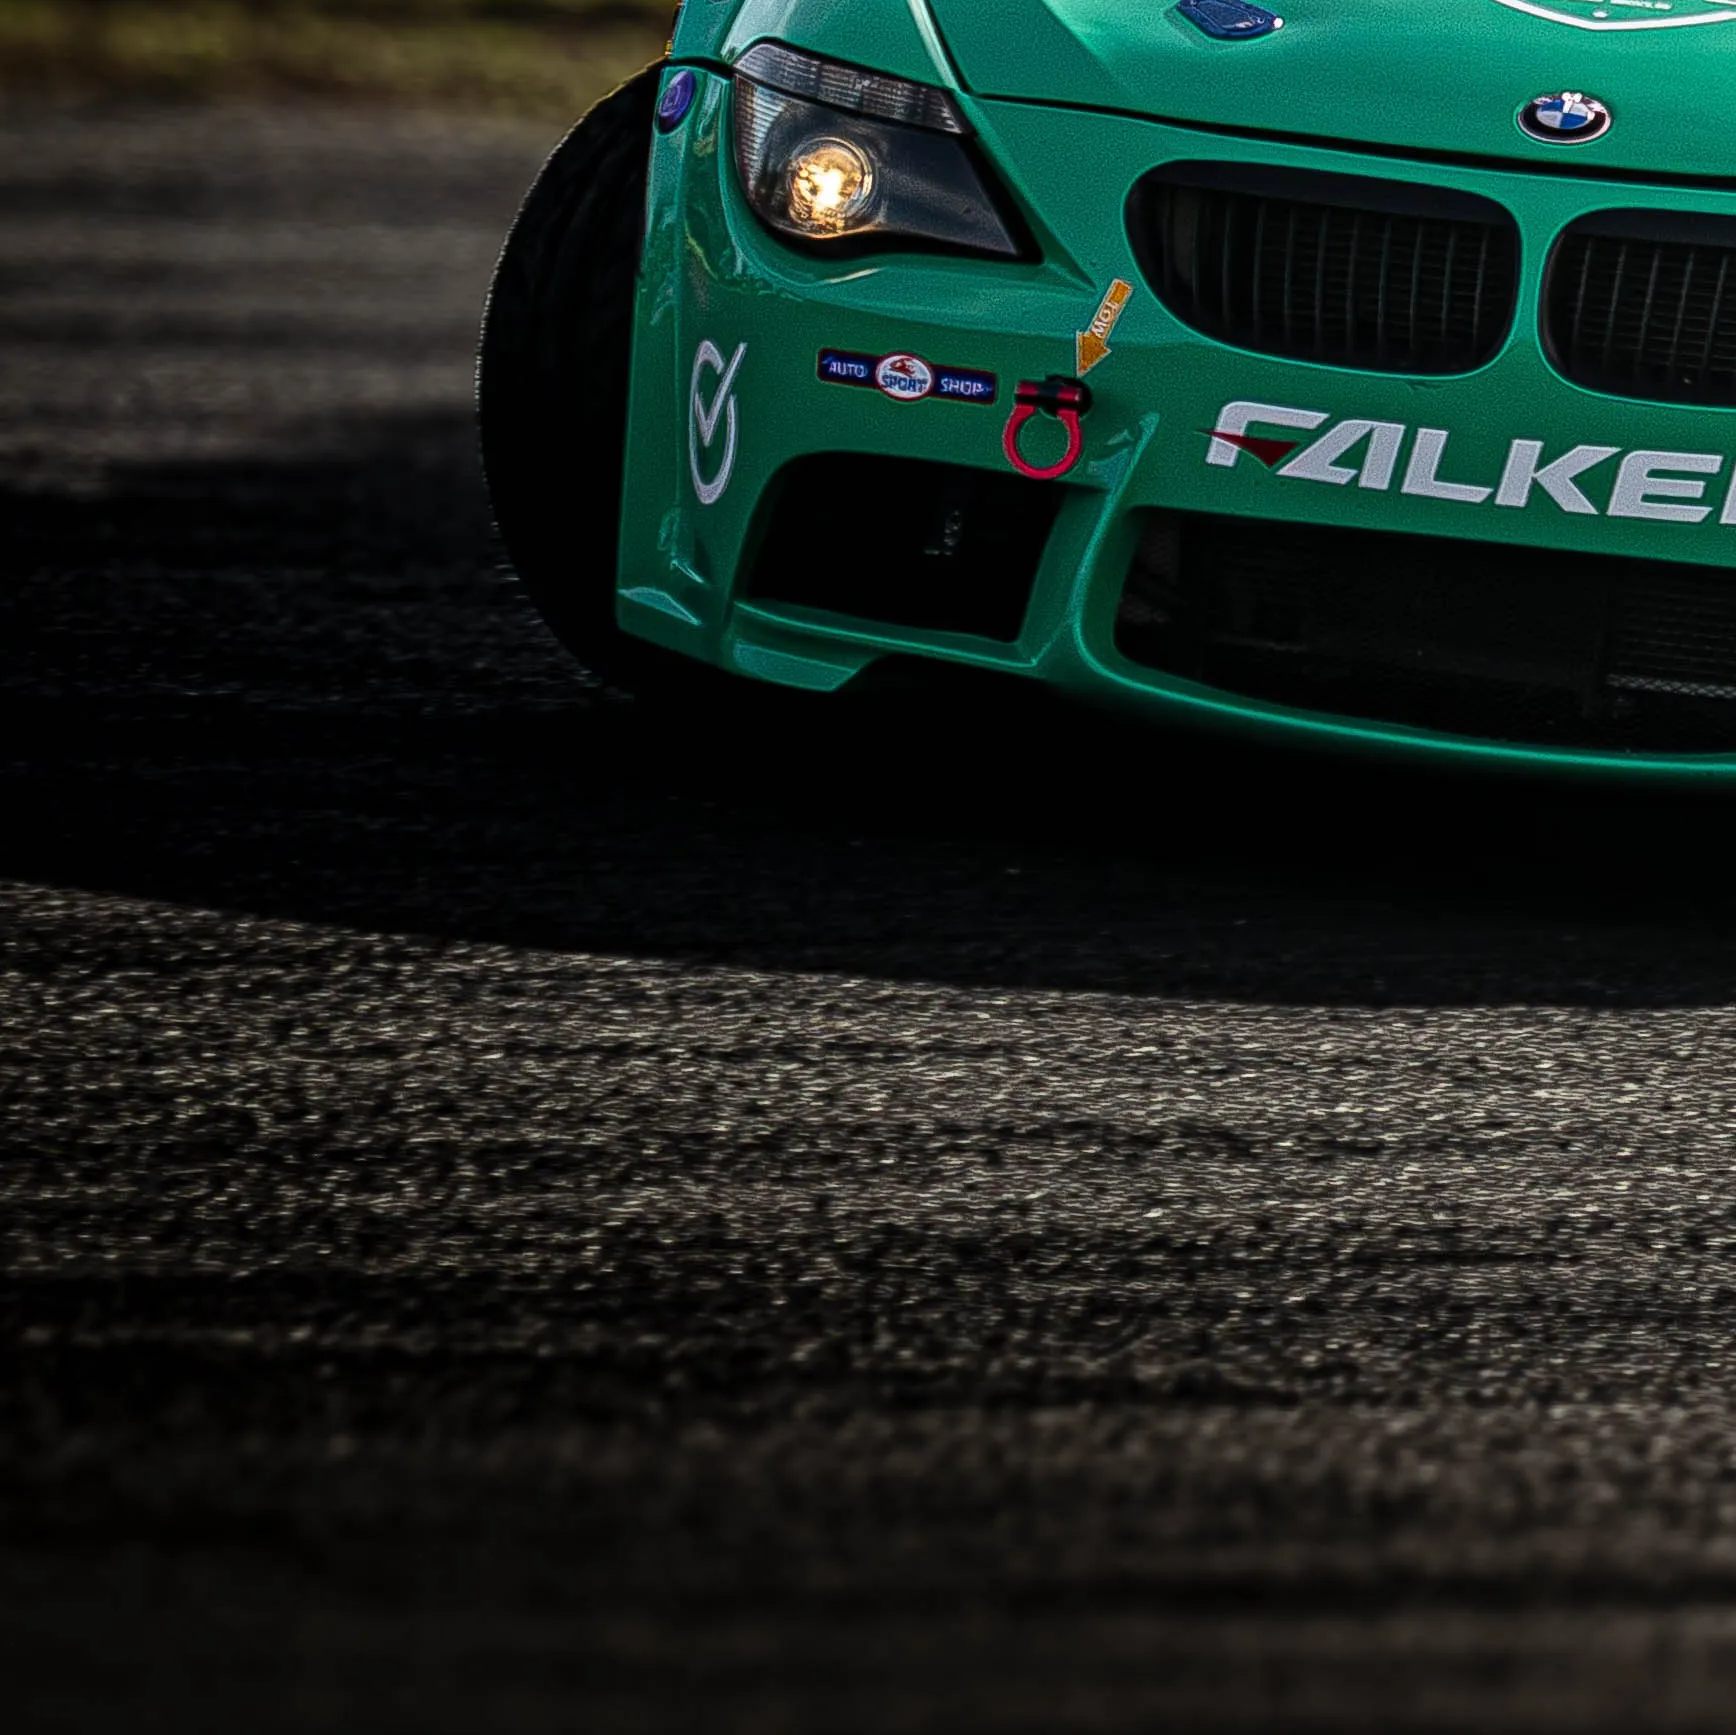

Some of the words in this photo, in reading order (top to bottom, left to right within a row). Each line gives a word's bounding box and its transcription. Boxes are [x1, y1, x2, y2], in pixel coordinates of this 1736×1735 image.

[1090, 300, 1118, 339] TOW
[828, 361, 868, 379] AUTO
[881, 374, 928, 393] SPORT
[940, 378, 985, 395] SHOP
